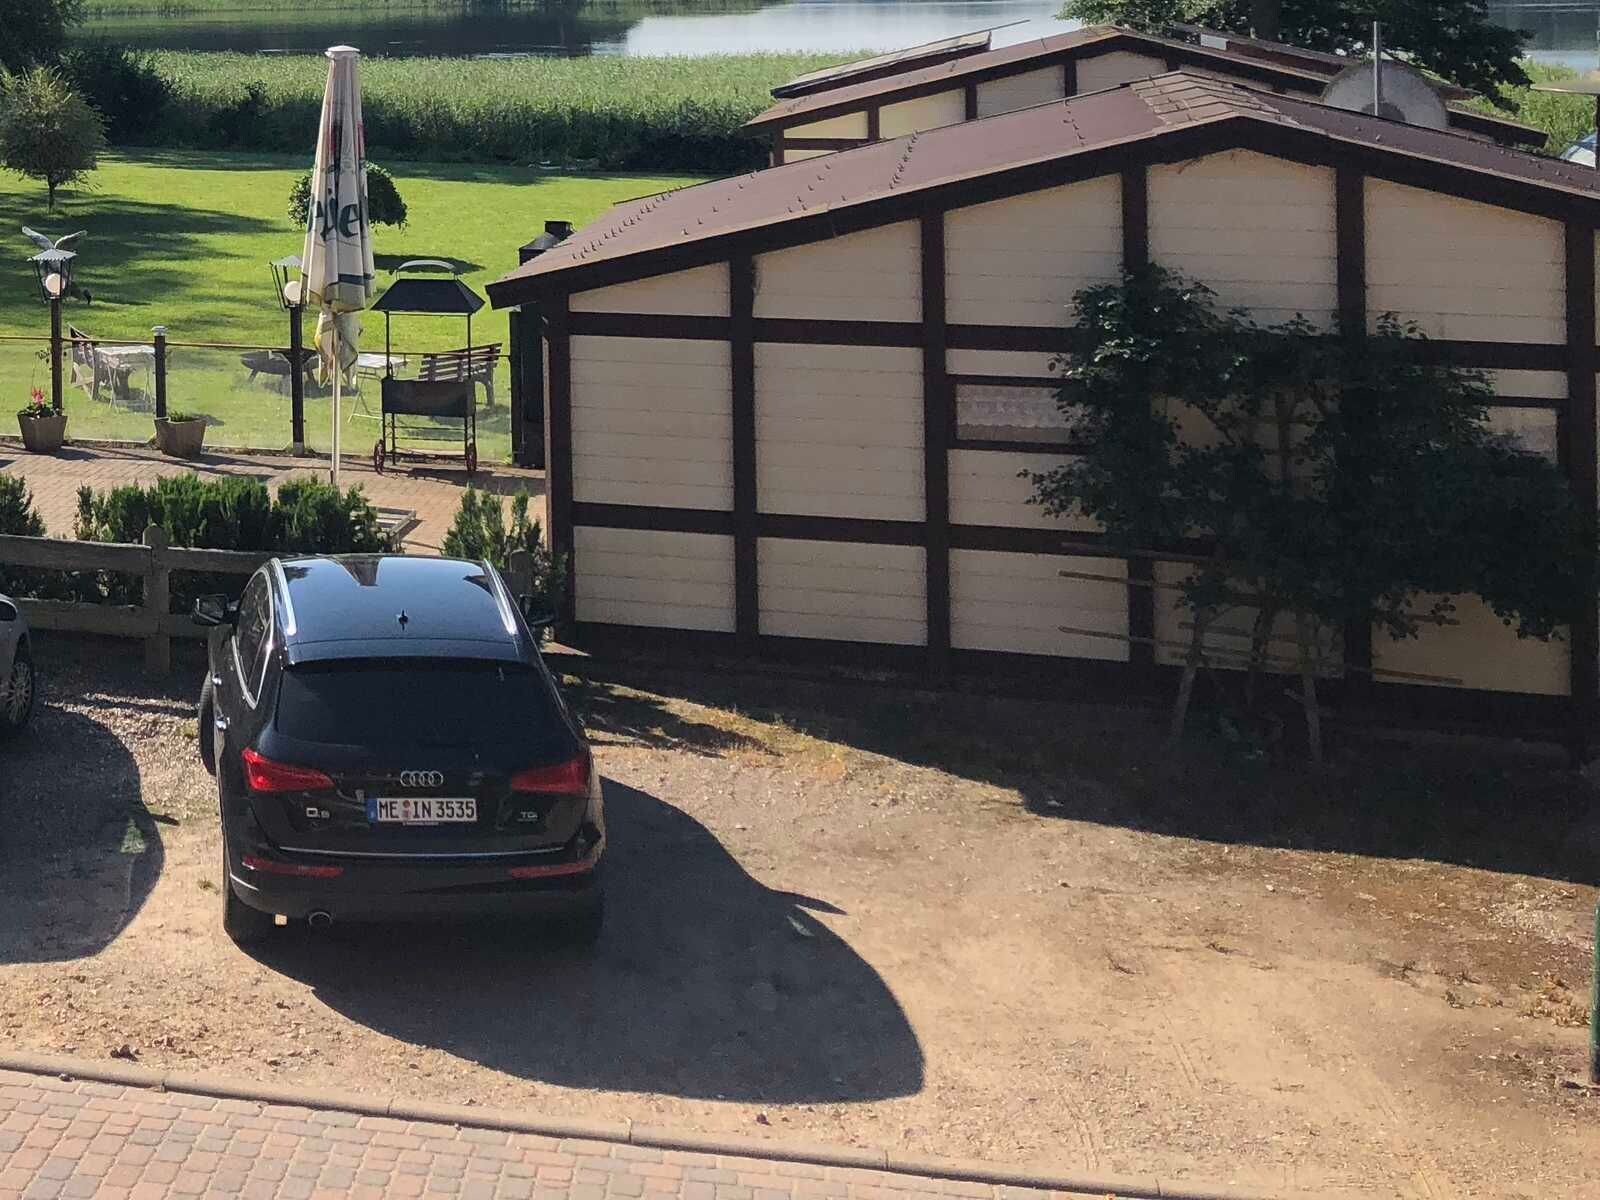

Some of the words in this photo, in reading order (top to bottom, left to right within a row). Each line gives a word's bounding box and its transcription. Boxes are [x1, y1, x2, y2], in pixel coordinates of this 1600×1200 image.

[379, 800, 399, 819] ME
[413, 800, 432, 819] IN
[436, 801, 475, 819] 3535
